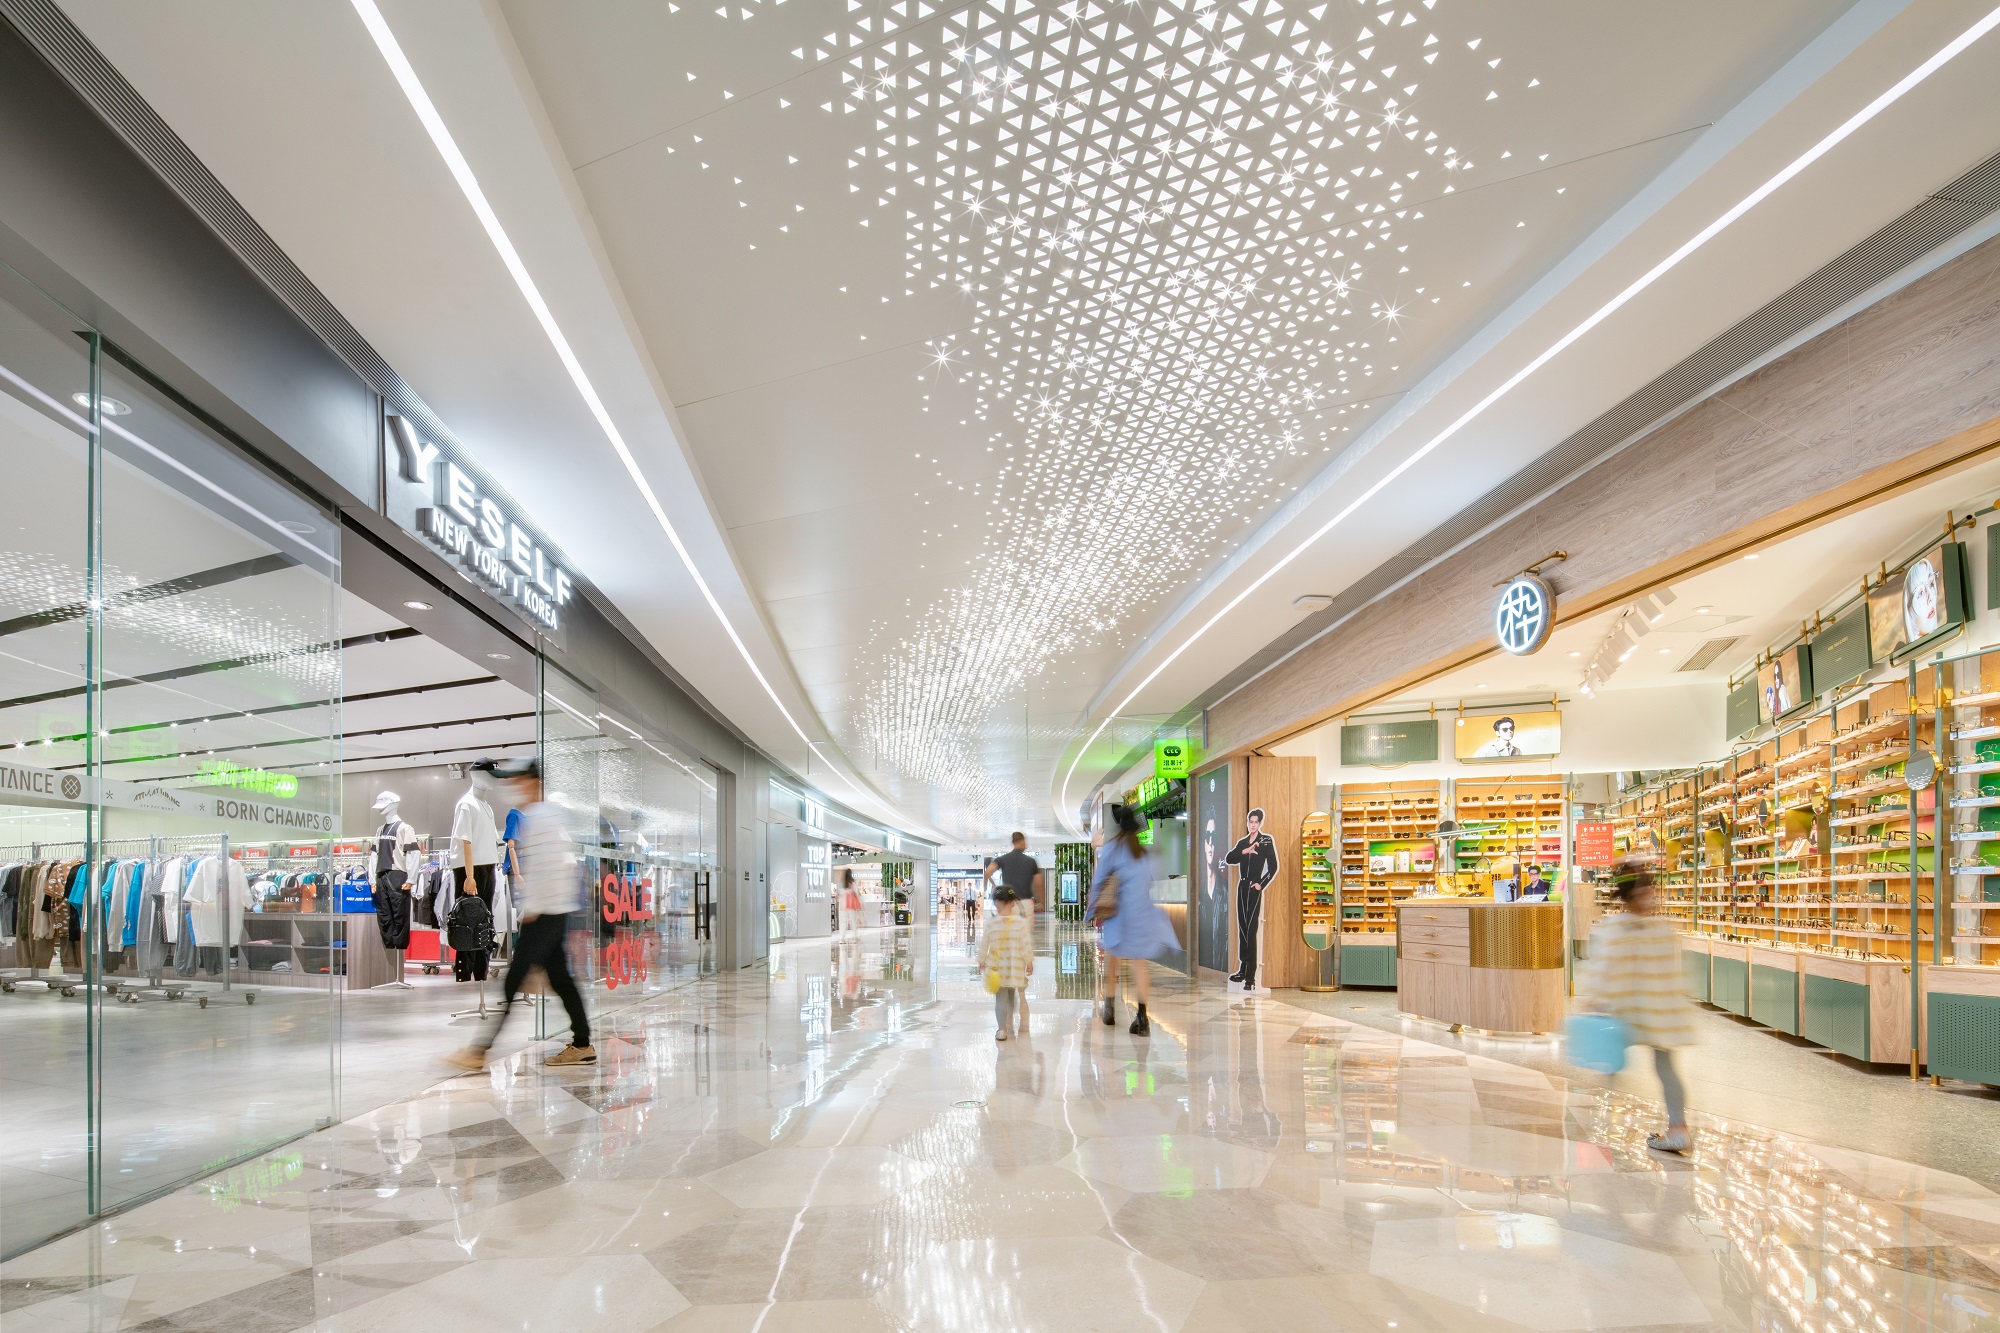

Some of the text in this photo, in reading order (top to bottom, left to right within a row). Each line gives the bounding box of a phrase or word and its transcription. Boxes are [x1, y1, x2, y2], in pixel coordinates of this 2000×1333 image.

[396, 415, 571, 606] YESELF
[432, 507, 468, 556] NEW
[473, 541, 508, 590] YORK
[524, 586, 558, 630] KOREA
[216, 799, 259, 822] BORN
[264, 806, 320, 830] CHAMPS
[807, 845, 825, 863] TOP
[807, 868, 825, 886] TOY
[603, 873, 652, 923] SALE
[606, 940, 648, 990] 30%
